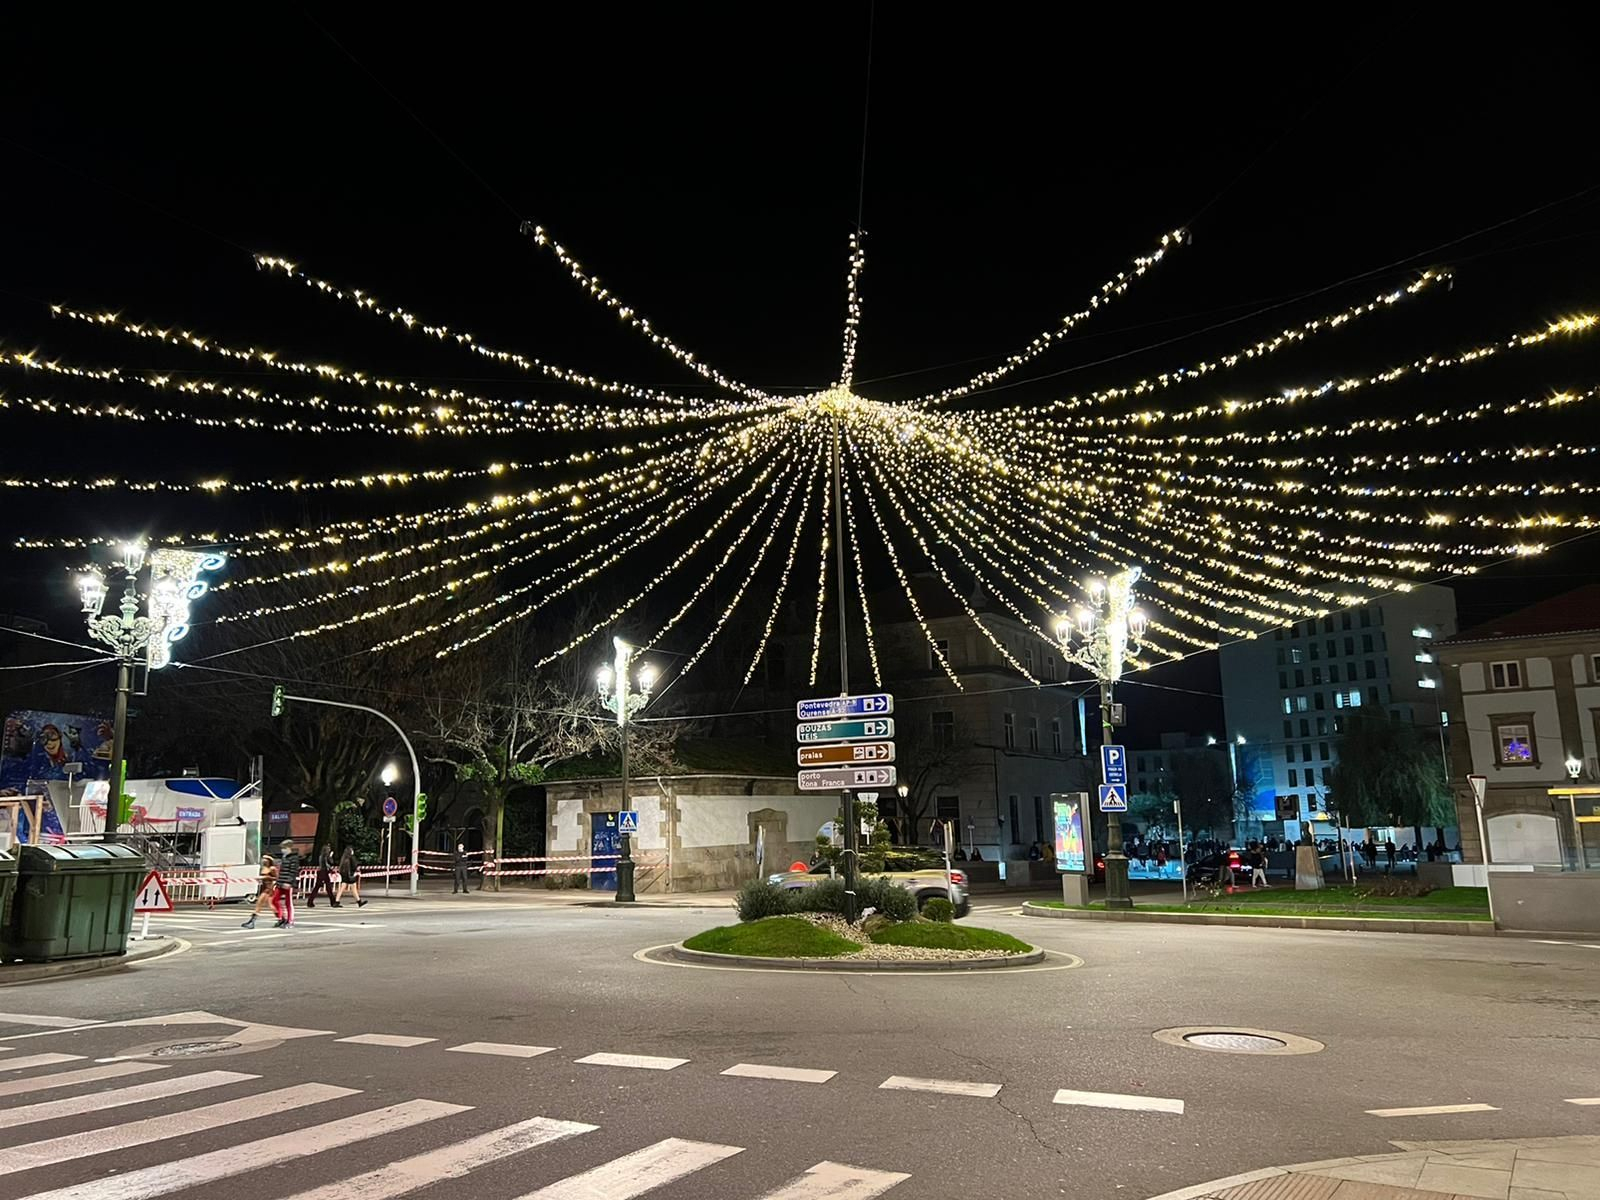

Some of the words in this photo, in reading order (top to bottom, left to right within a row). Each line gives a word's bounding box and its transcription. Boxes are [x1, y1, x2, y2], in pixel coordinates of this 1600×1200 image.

[800, 701, 840, 709] Pontevedra
[800, 709, 831, 717] Ourense
[800, 724, 831, 733] BOUZAS
[800, 752, 823, 760] praias
[1109, 750, 1119, 764] P
[801, 772, 820, 781] porto
[801, 780, 818, 788] Zona
[821, 779, 845, 787] Franca
